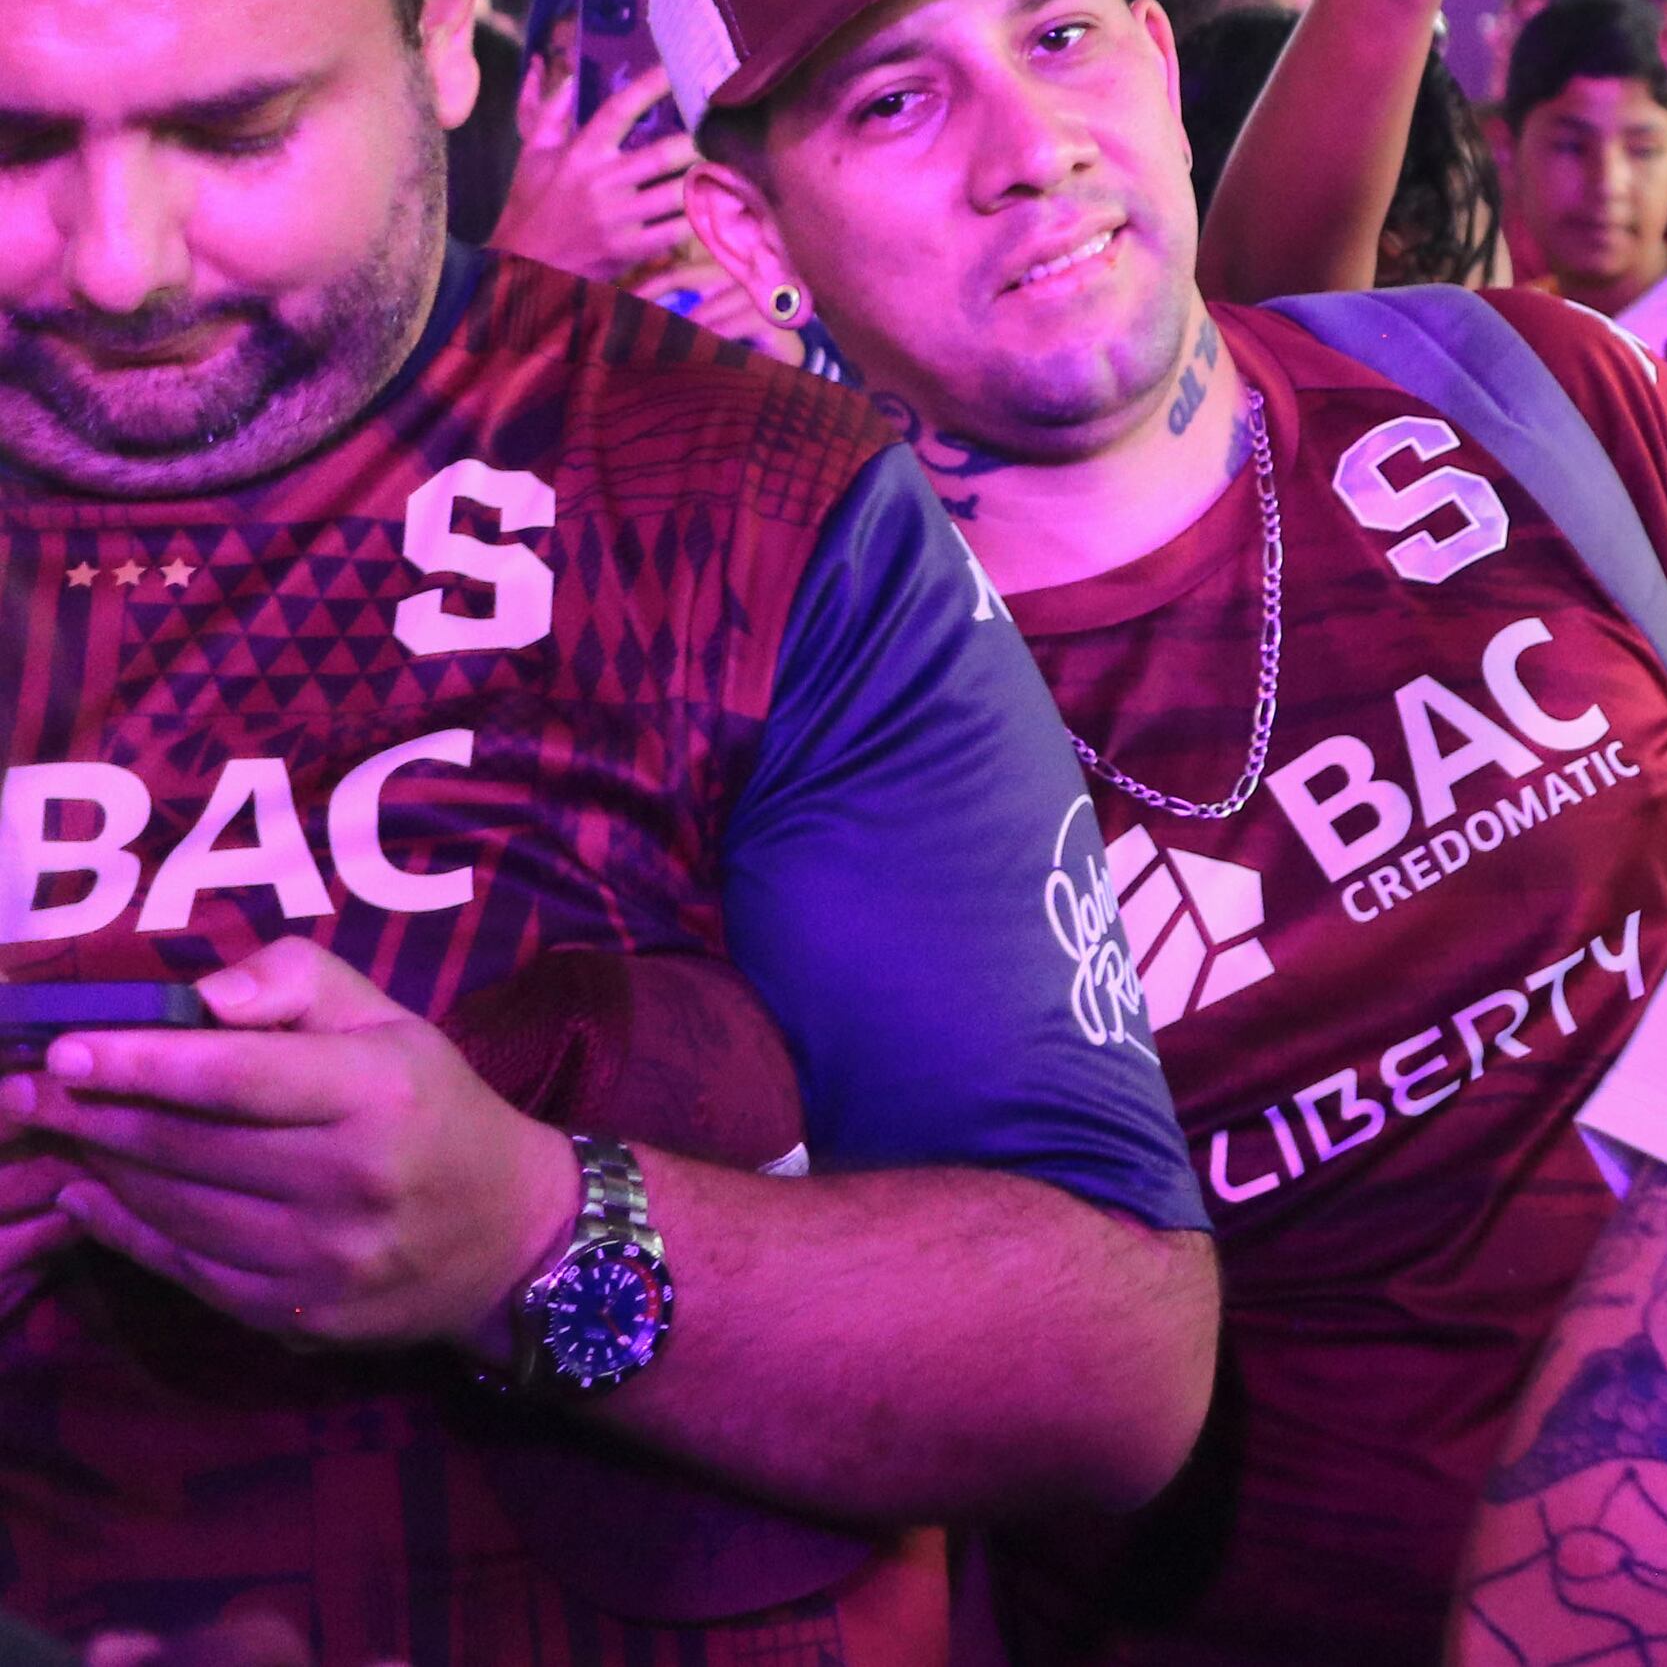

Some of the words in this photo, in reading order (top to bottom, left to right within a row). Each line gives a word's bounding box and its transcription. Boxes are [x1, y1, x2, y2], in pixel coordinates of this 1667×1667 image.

[397, 457, 557, 657] S
[1332, 415, 1510, 585] S
[0, 727, 475, 944] BAC
[1266, 616, 1611, 882] BAC
[1340, 740, 1640, 924] CREDOMATIC
[1209, 910, 1645, 1203] LIBERTY
